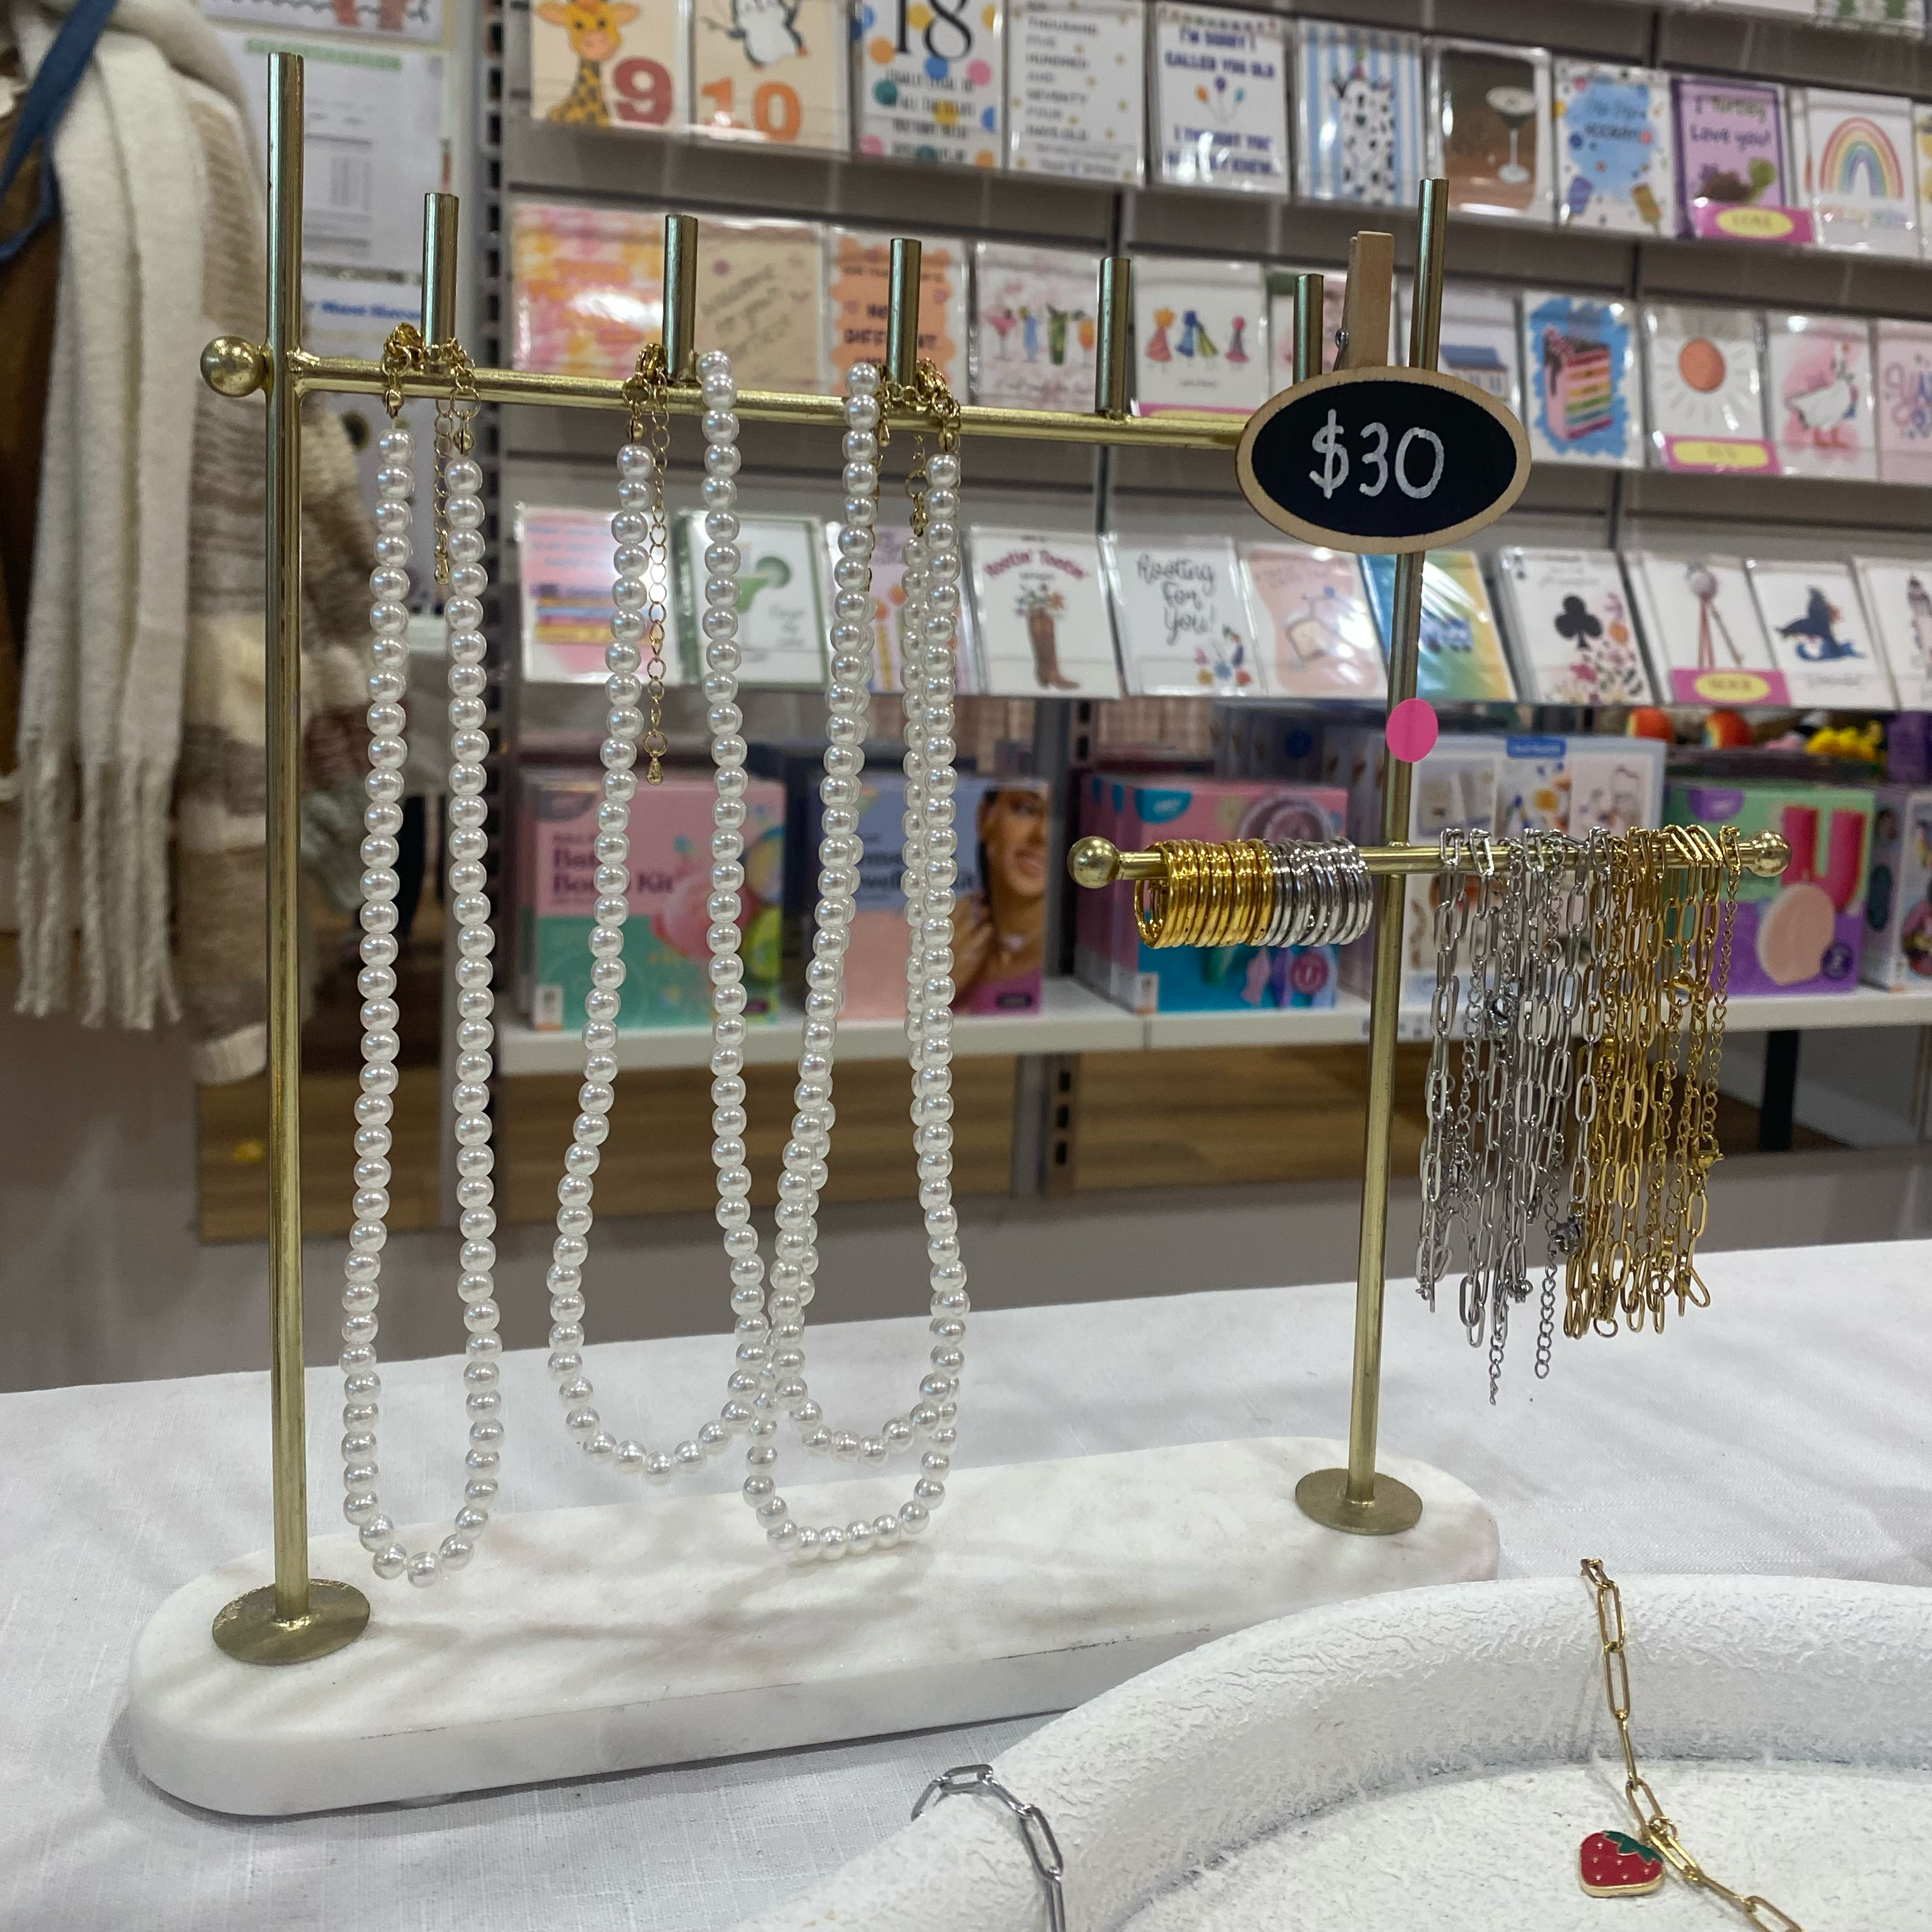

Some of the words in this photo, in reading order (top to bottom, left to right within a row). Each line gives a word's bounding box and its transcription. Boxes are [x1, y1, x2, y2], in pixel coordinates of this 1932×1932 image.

[895, 0, 973, 61] 18
[615, 56, 673, 125] 9
[702, 77, 802, 141] 10
[1309, 408, 1445, 499] $30
